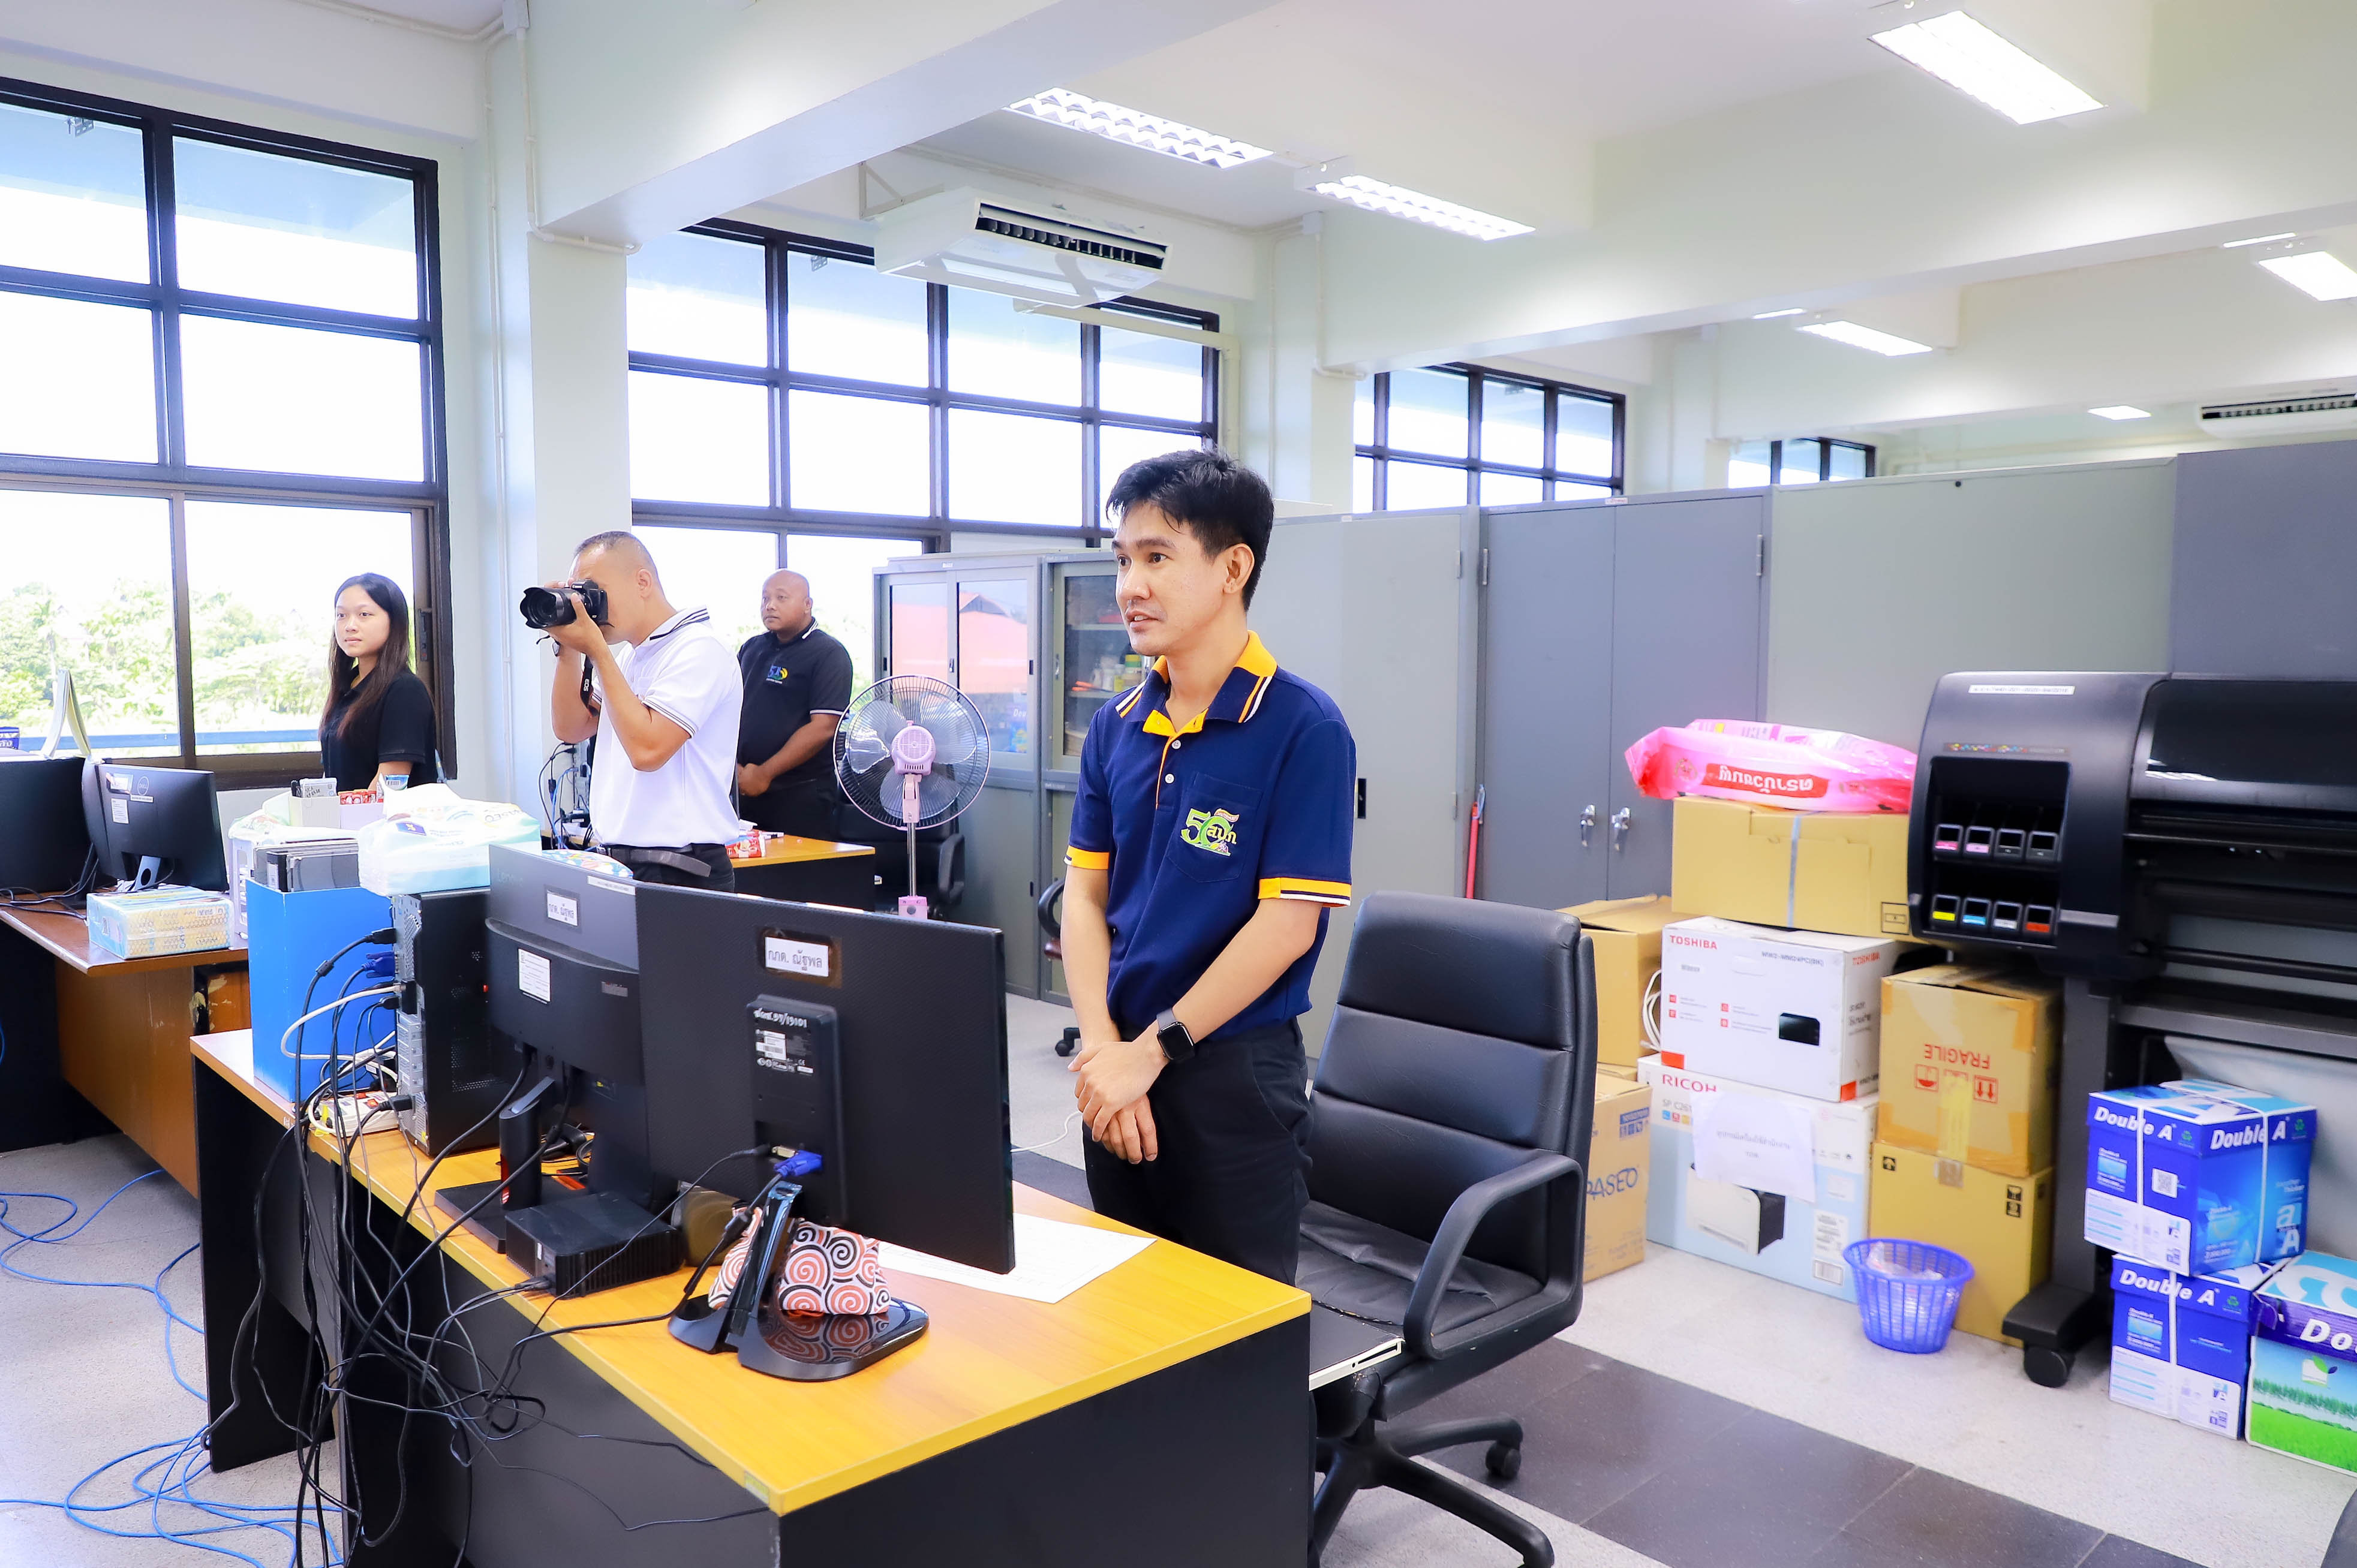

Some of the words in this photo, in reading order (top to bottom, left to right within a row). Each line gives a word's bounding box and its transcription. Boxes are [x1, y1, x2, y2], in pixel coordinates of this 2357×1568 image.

[1719, 765, 1814, 794] ตราบัวชมพู
[1670, 935, 1718, 950] TOSHIBA
[1924, 1043, 1991, 1070] FRAGILE
[1662, 1074, 1716, 1092] RICOH
[2094, 1106, 2154, 1135] Double
[2157, 1124, 2173, 1141] A
[2209, 1124, 2266, 1150] Double
[2271, 1121, 2286, 1140] A
[2119, 1269, 2193, 1300] Double
[2197, 1289, 2215, 1307] A
[2299, 1318, 2357, 1355] Do
